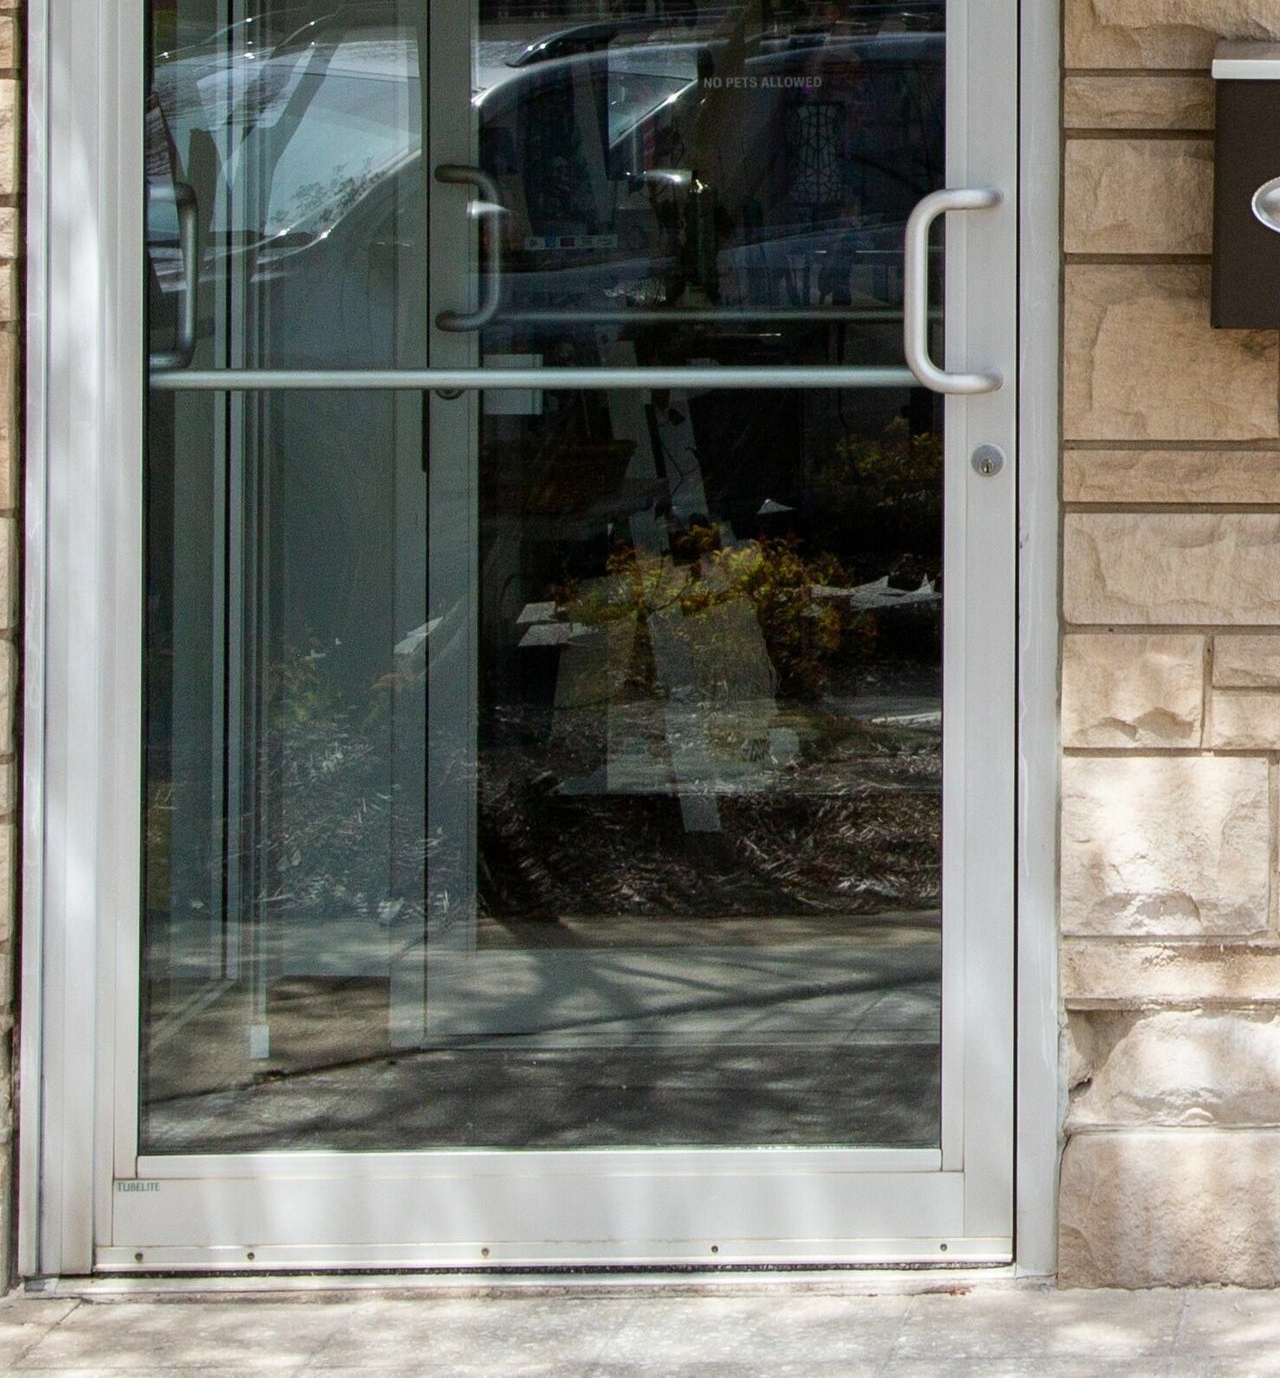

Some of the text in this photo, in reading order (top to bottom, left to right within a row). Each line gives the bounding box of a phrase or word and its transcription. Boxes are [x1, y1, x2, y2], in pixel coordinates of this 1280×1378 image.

[704, 76, 822, 88] NO PETS ALLOWED
[117, 1182, 160, 1192] TUBELITE
